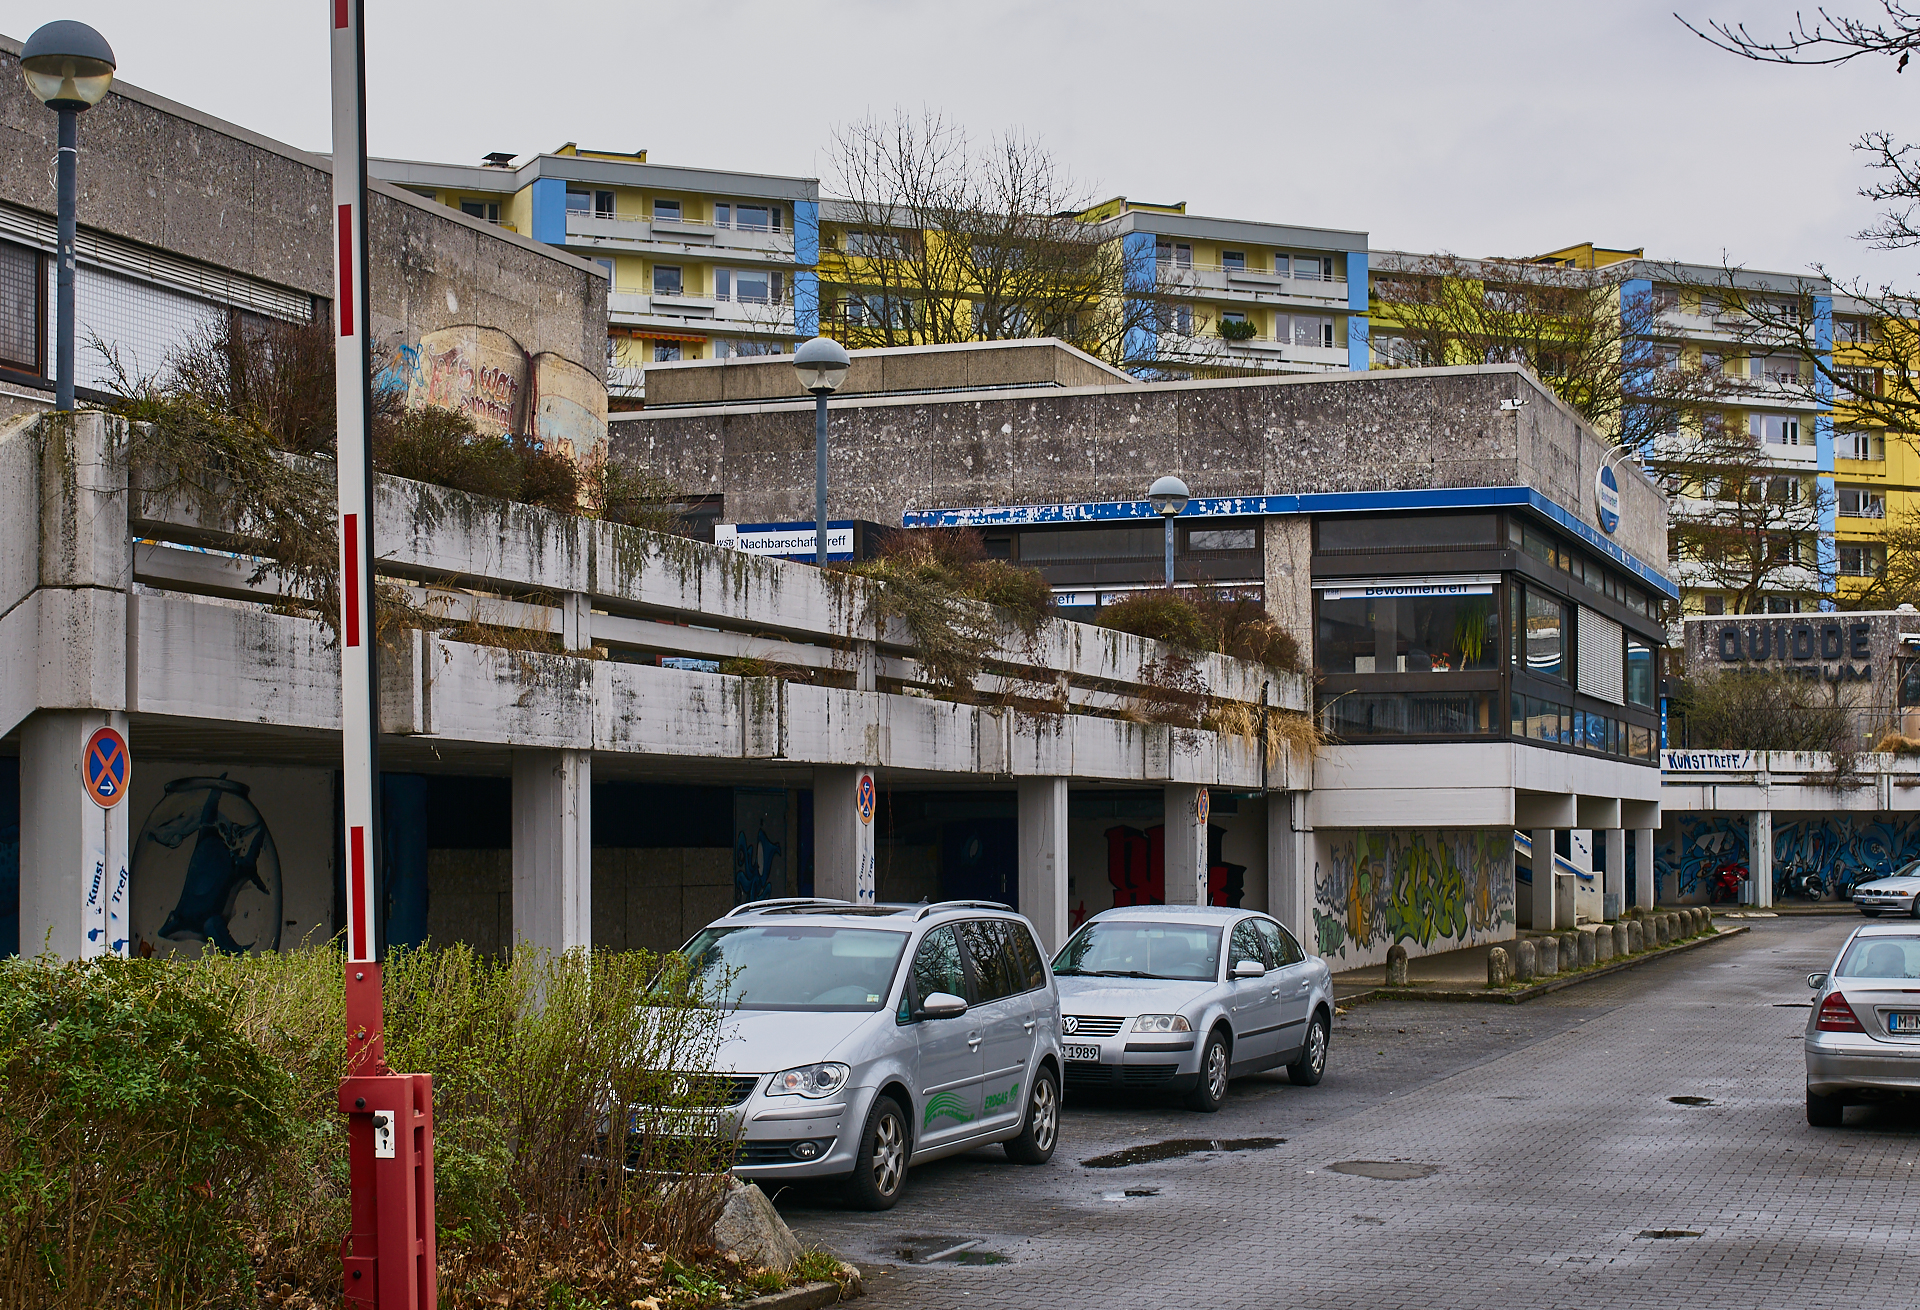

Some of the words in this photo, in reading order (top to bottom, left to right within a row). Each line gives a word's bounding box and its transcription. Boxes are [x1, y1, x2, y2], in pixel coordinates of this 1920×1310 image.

[479, 364, 519, 405] war
[460, 395, 516, 434] einmal
[740, 535, 847, 550] Nachbarschaftreff
[1719, 623, 1870, 661] QUIDDE
[111, 865, 129, 904] Treff
[1898, 1015, 1907, 1028] M
[1068, 1046, 1097, 1059] 1989
[984, 1090, 1009, 1110] ERDGAS
